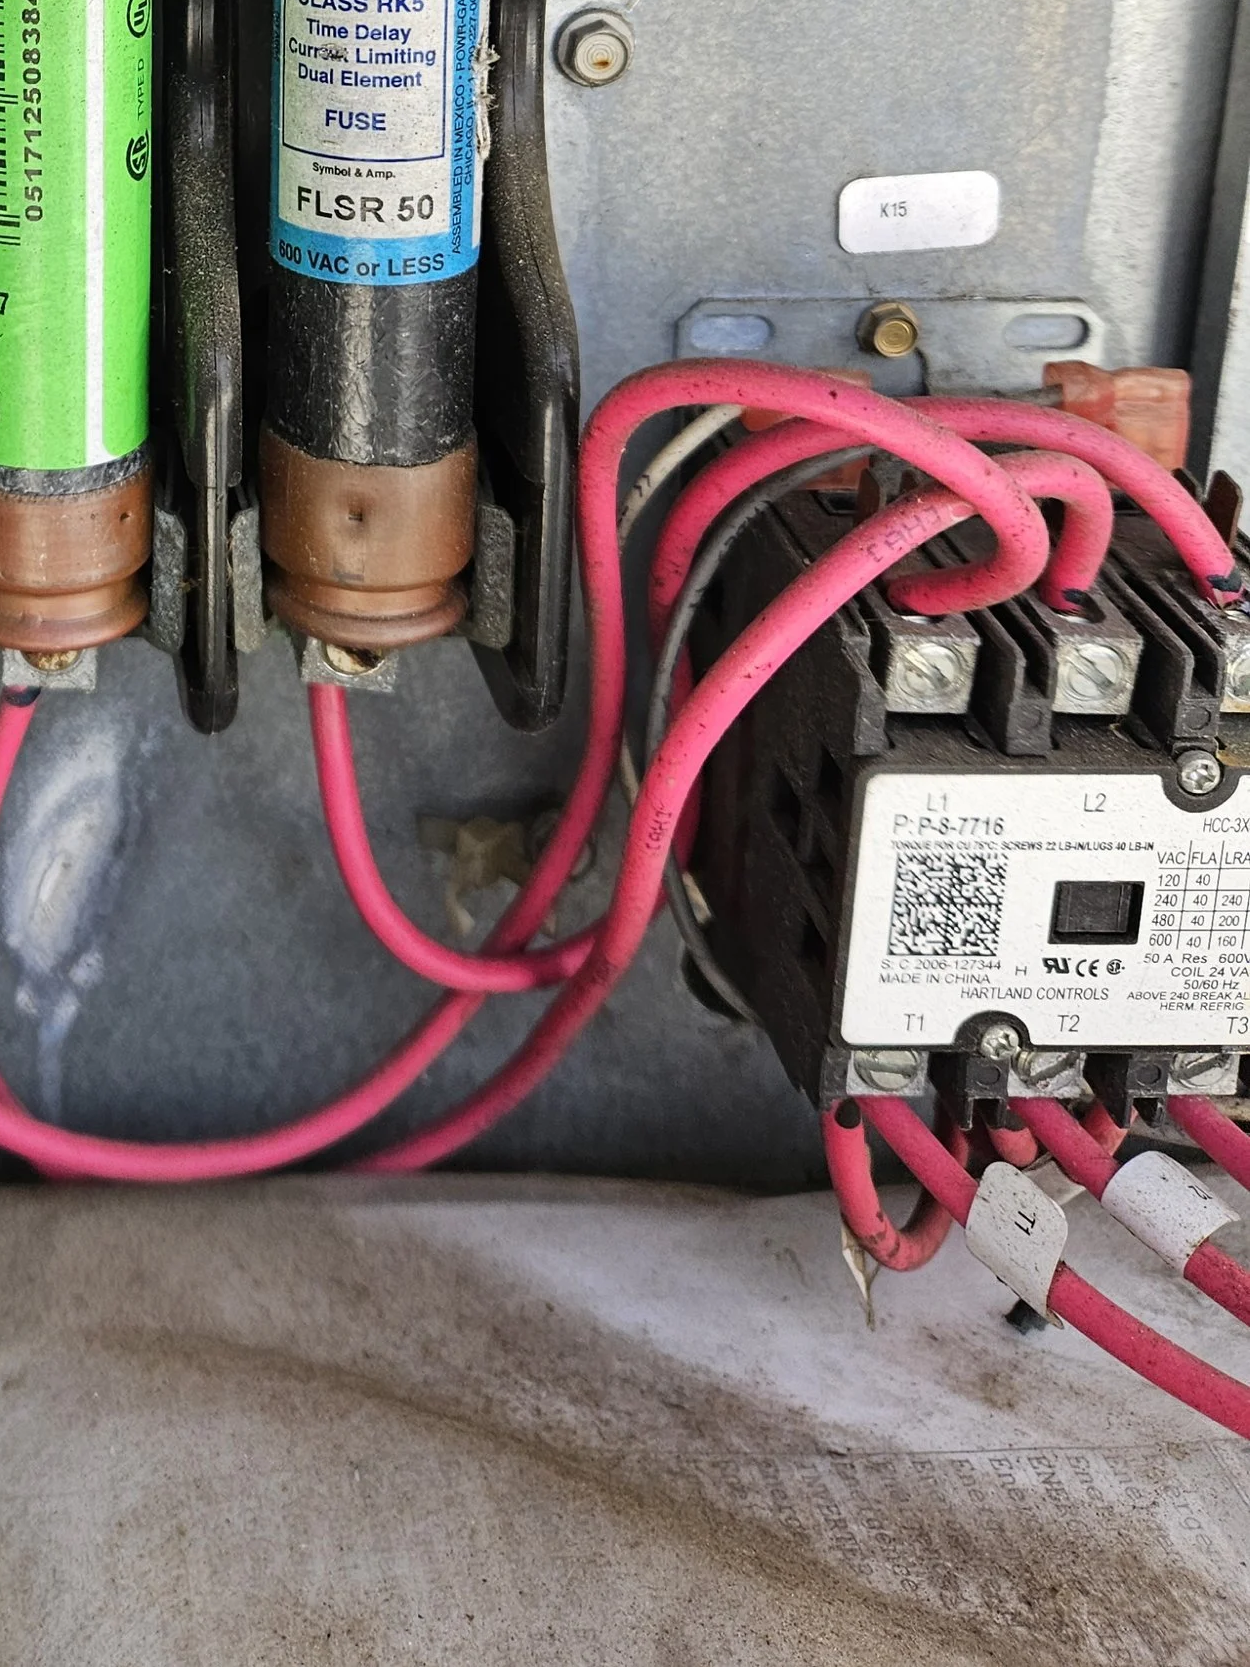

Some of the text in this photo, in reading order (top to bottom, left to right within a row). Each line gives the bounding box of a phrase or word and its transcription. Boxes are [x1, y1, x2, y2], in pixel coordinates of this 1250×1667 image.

[306, 18, 412, 45] Time Delay
[355, 48, 437, 66] Limiting
[298, 63, 423, 88] Dual Element
[137, 74, 145, 120] TYPE
[325, 108, 387, 131] FUSE
[455, 85, 465, 145] MEXICO
[454, 146, 463, 163] IN
[312, 162, 396, 180] Symbol & Amp.
[297, 186, 434, 223] FLSR 50
[452, 165, 464, 254] ASSEMBLED
[879, 201, 908, 218] K15
[278, 239, 444, 277] 600 VAC or LESS
[926, 792, 947, 812] L1
[1083, 793, 1107, 812] L2
[893, 814, 913, 835] P:
[1000, 841, 1042, 851] SCREWS
[1045, 841, 1056, 851] 22
[1058, 841, 1113, 851] LB-IN/LUGS
[1129, 841, 1155, 851] LB-IN
[1157, 852, 1250, 864] VAC FLA LRA
[1158, 874, 1211, 887] 120 40
[1154, 894, 1243, 907] 240 40 240
[1152, 914, 1240, 927] 480 40 200
[1149, 933, 1237, 948] 600 40 160
[913, 959, 1001, 970] 2006-127344
[1143, 953, 1160, 964] 50
[1163, 953, 1174, 964] A
[1181, 953, 1208, 964] Res
[878, 973, 991, 984] MADE IN CHINA
[1014, 965, 1027, 976] H
[1171, 967, 1205, 977] COIL
[1209, 967, 1225, 977] 24
[960, 987, 1109, 1001] HARTLAND CONTROLS
[1183, 980, 1240, 990] 50/60 Hz
[1126, 991, 1167, 1001] ABOVE
[1170, 991, 1190, 1001] 240
[1192, 991, 1232, 1001] BREAK
[904, 1013, 924, 1031] T1
[1057, 1014, 1081, 1032] T2
[1227, 1016, 1249, 1035] T3
[1014, 1210, 1036, 1236] T1
